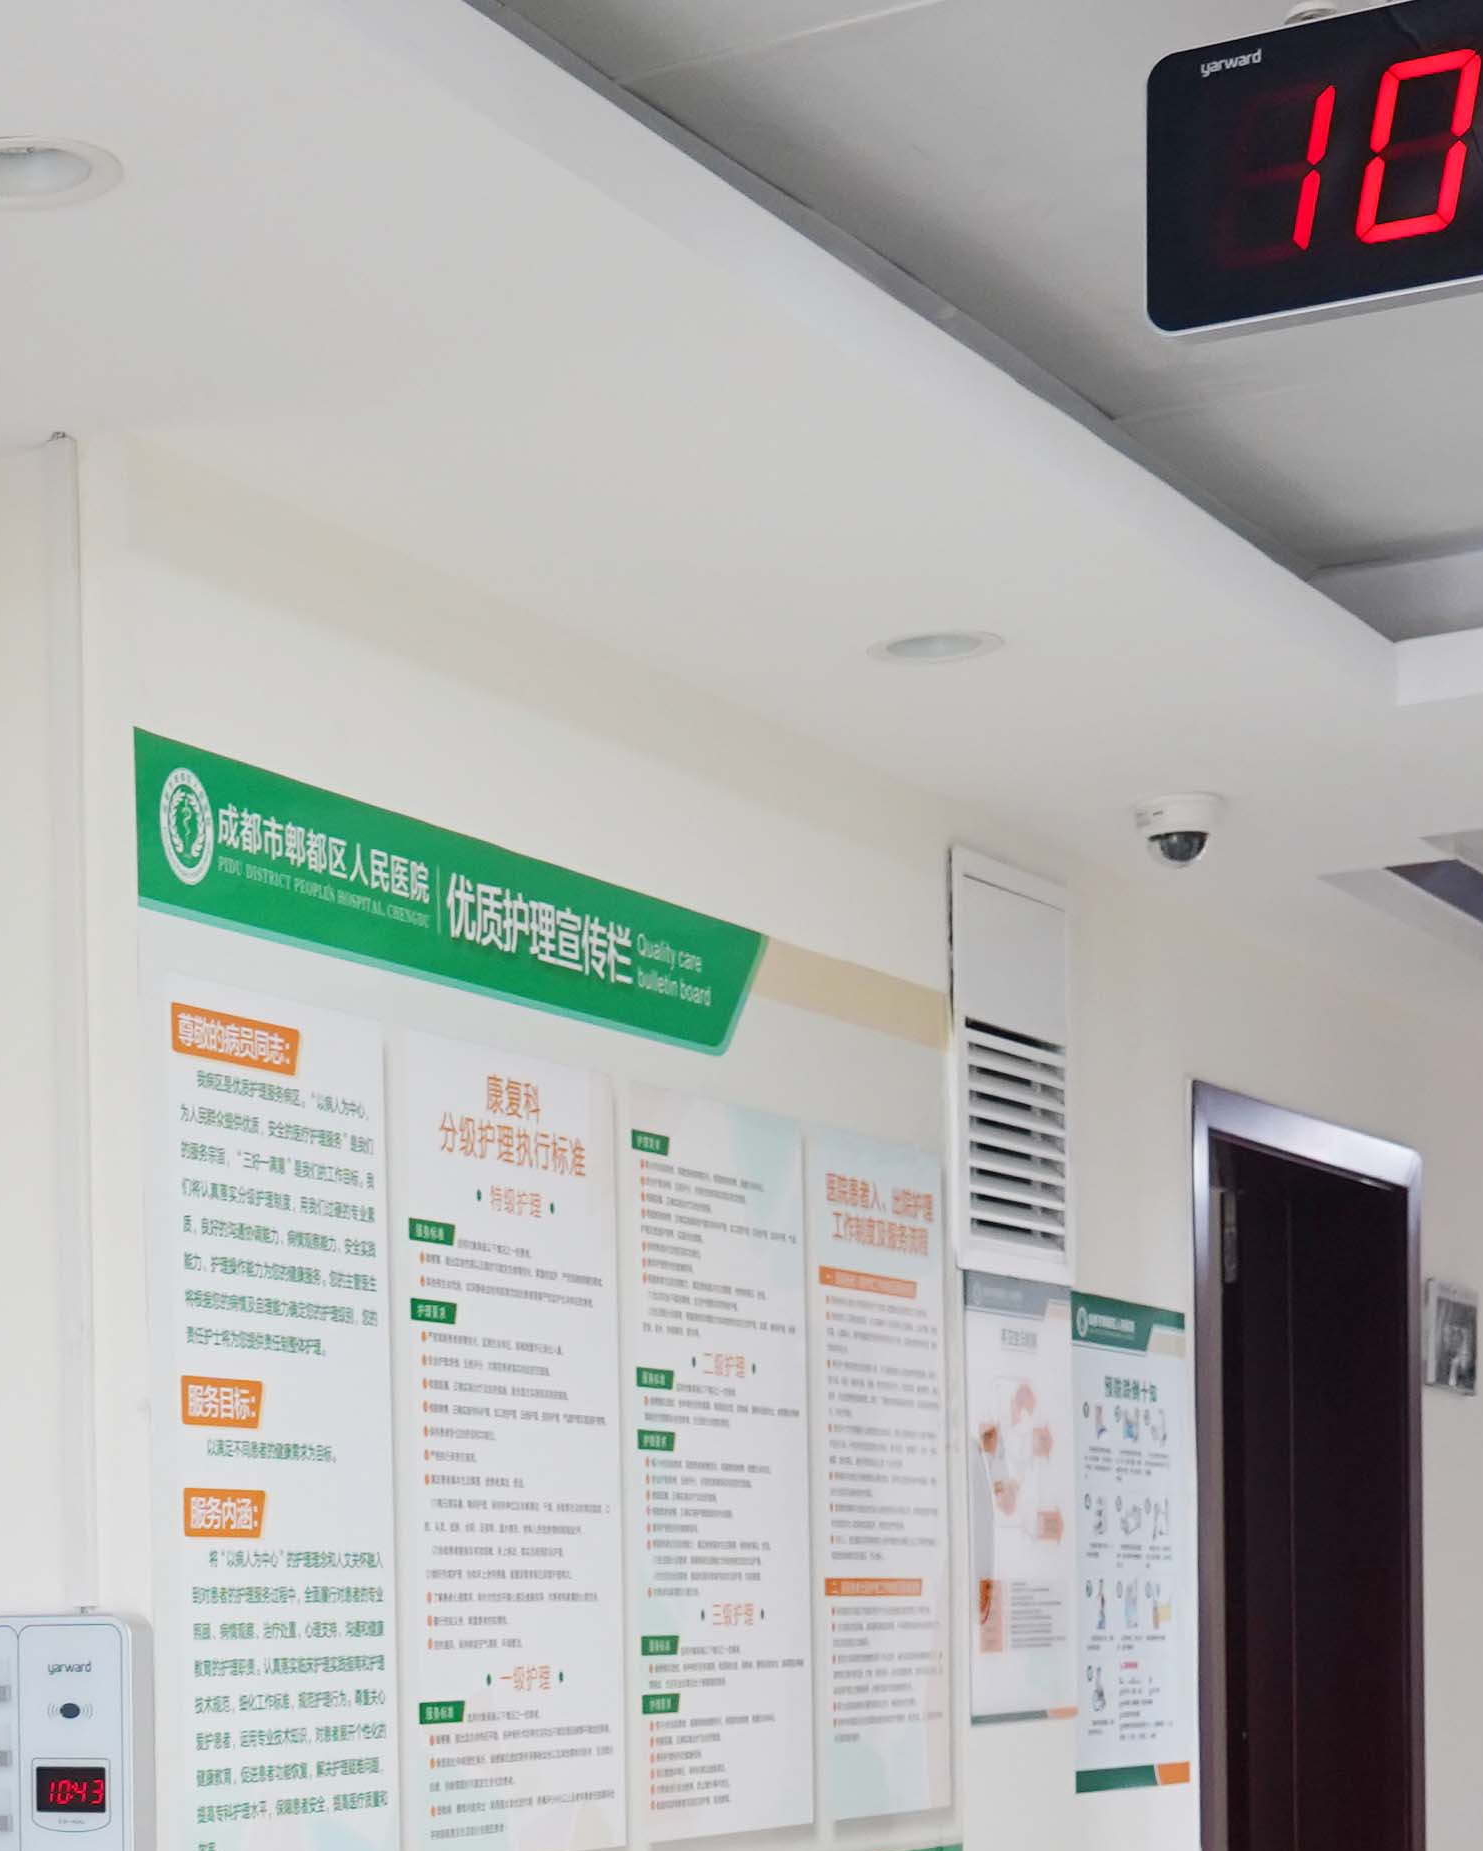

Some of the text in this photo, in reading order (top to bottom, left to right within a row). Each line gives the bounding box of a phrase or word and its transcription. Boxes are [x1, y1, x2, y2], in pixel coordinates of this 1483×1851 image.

[1199, 48, 1262, 77] yarward
[1293, 48, 1482, 251] 10
[217, 803, 430, 905] 成都市郫都区人民医院
[446, 871, 633, 986] 优质护理宣传栏
[637, 932, 703, 973] Quality care
[486, 1074, 542, 1123] 康复科
[439, 1111, 587, 1178] 分级护理执行标准
[47, 1661, 92, 1675] yarward
